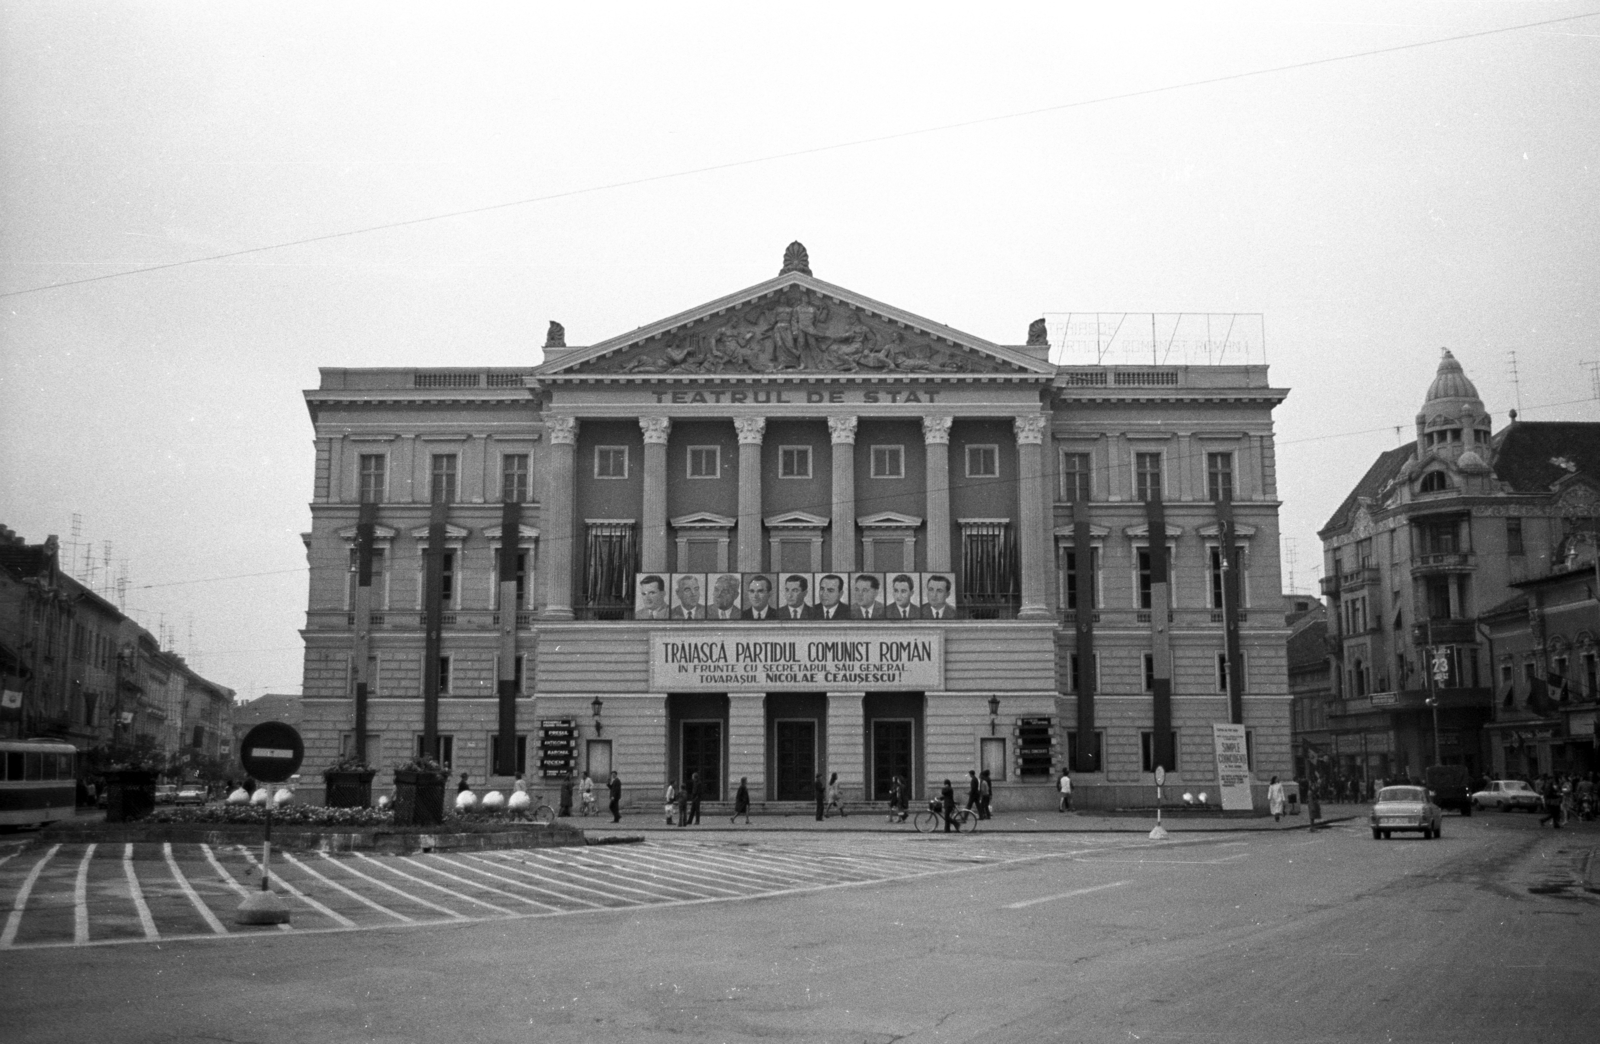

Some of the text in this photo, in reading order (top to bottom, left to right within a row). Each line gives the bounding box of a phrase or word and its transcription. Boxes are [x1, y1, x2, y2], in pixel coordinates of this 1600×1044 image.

[652, 390, 939, 404] TEATRUL DE STAT
[735, 642, 801, 663] PARTIDUL
[807, 641, 872, 662] COMUNIST
[693, 664, 738, 673] FRUNTE
[743, 664, 758, 672] CU
[762, 664, 829, 673] SECRETARUL
[1432, 658, 1449, 673] 23
[765, 672, 819, 683] NICOLAE
